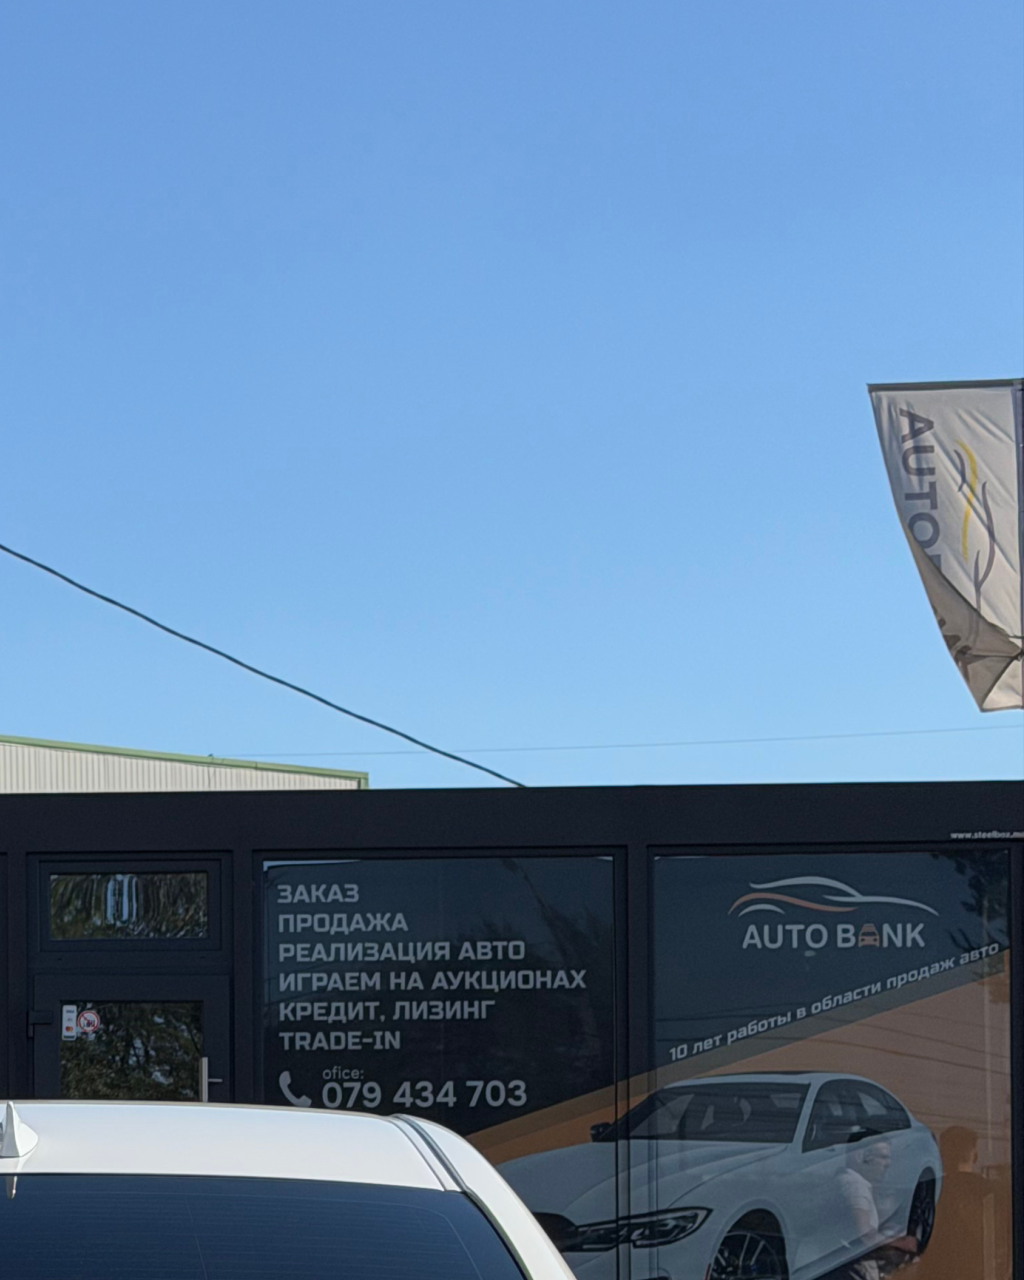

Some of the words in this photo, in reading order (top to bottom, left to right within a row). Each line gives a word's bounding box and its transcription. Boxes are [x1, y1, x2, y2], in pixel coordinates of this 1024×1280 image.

[277, 884, 360, 903] ЗАКАЗ
[278, 913, 409, 935] ПРОДАЖА
[742, 923, 828, 949] AUTO
[279, 941, 450, 963] РЕАЛИЗАЦИЯ
[458, 940, 526, 960] АВТО
[279, 972, 381, 992] ИГРАЕМ
[389, 971, 424, 990] НА
[431, 969, 587, 993] АУКЦИОНАХ
[279, 1002, 385, 1023] КРЕДИТ,
[393, 1000, 495, 1021] ЛИЗИНГ
[668, 1046, 687, 1061] 10
[692, 1035, 723, 1055] лет
[727, 1011, 792, 1046] работы
[796, 1007, 807, 1019] в
[811, 981, 882, 1014] области
[886, 956, 956, 990] продаж
[959, 942, 1000, 966] авто
[278, 1030, 401, 1050] TRADE-IN
[322, 1066, 364, 1080] ofice:
[322, 1081, 382, 1109] 079
[393, 1080, 457, 1108] 434
[466, 1079, 528, 1108] 703
